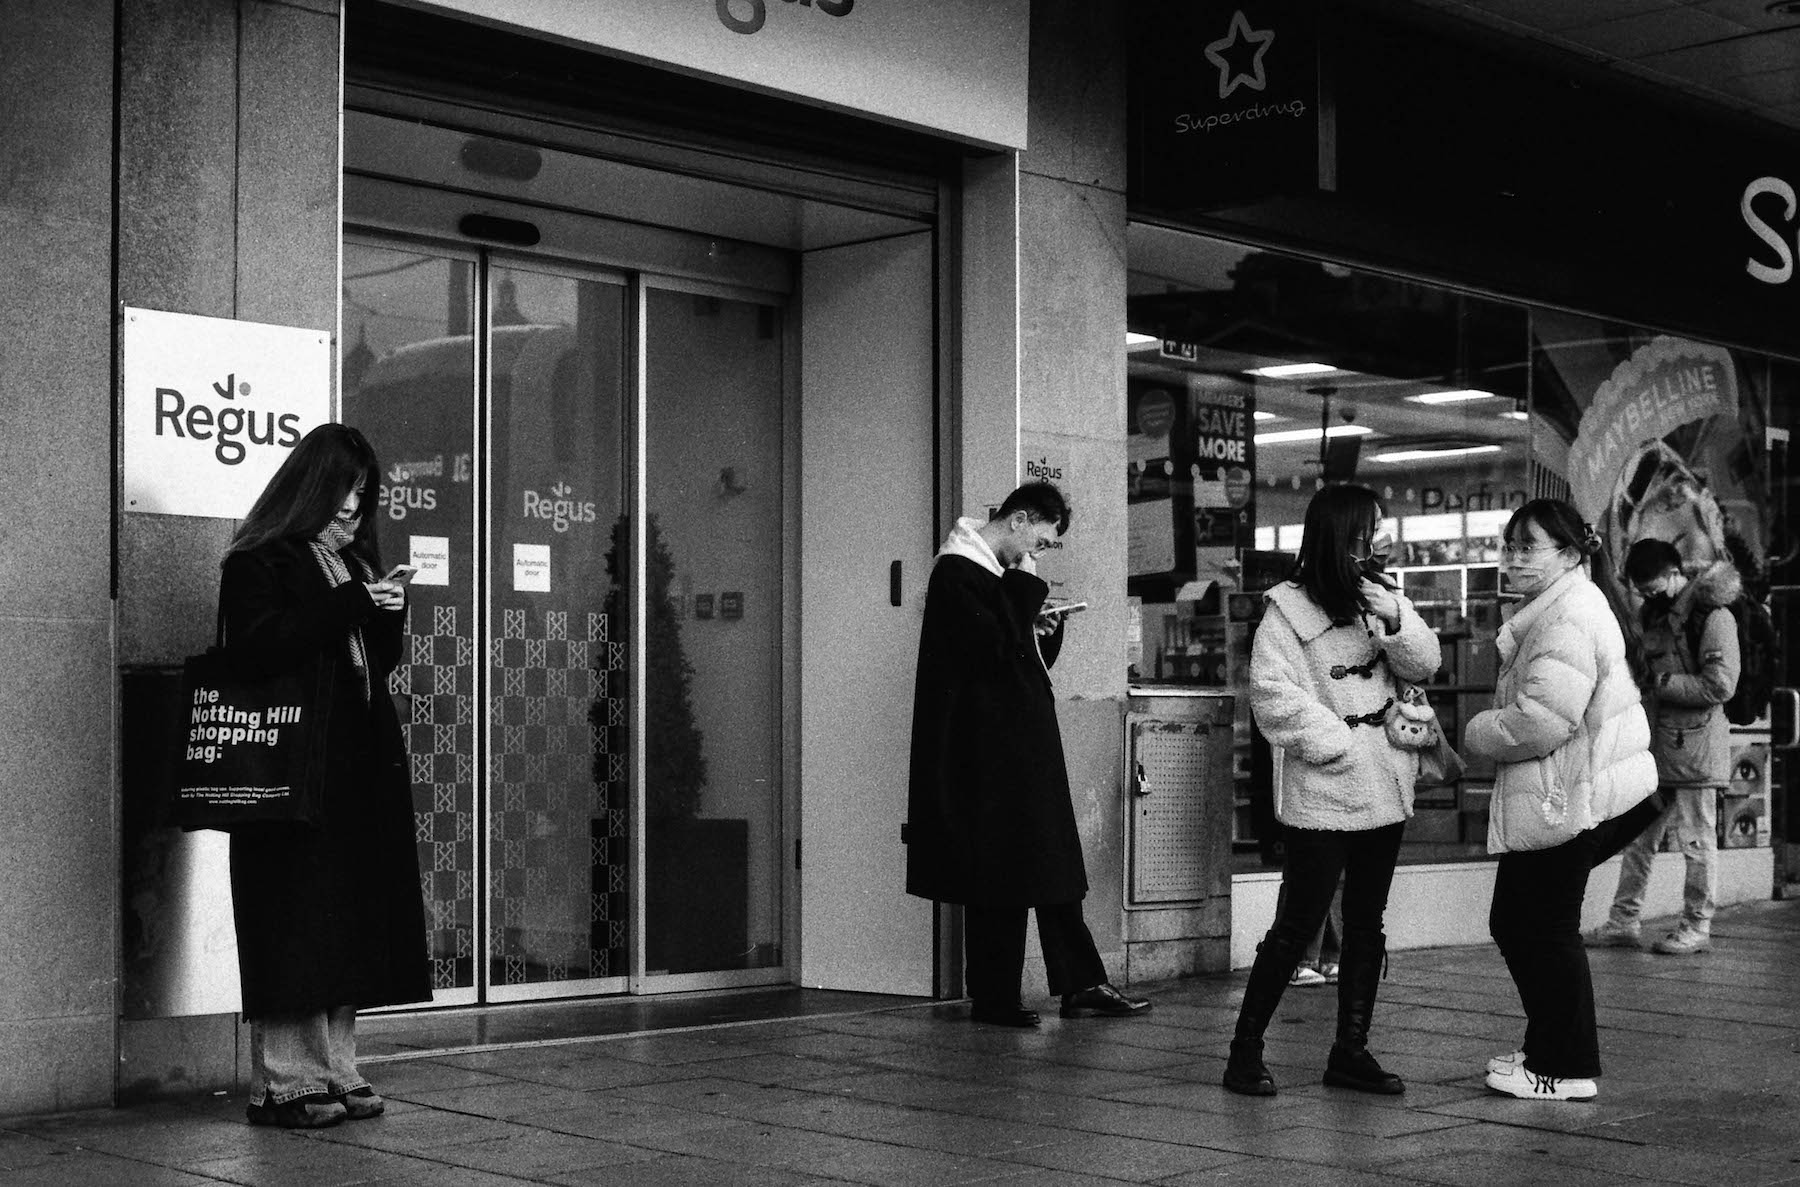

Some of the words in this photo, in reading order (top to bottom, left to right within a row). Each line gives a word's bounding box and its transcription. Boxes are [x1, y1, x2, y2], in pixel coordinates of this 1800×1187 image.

[1175, 100, 1307, 133] Superdrug
[1741, 176, 1800, 284] S
[155, 386, 301, 466] Regus
[1199, 408, 1246, 437] SAVE
[1587, 365, 1717, 481] MAYBELLINE
[1199, 435, 1246, 462] MORE
[1026, 461, 1062, 483] Regus
[378, 484, 437, 520] egus
[523, 489, 596, 533] Regus
[412, 551, 447, 560] Automatic
[421, 560, 438, 570] door
[516, 558, 548, 568] Automatic
[524, 568, 540, 577] door
[193, 687, 220, 705] the
[191, 705, 261, 729] Notting
[266, 706, 302, 724] Hill
[189, 723, 279, 747] shopping
[1534, 1075, 1557, 1095] NY
